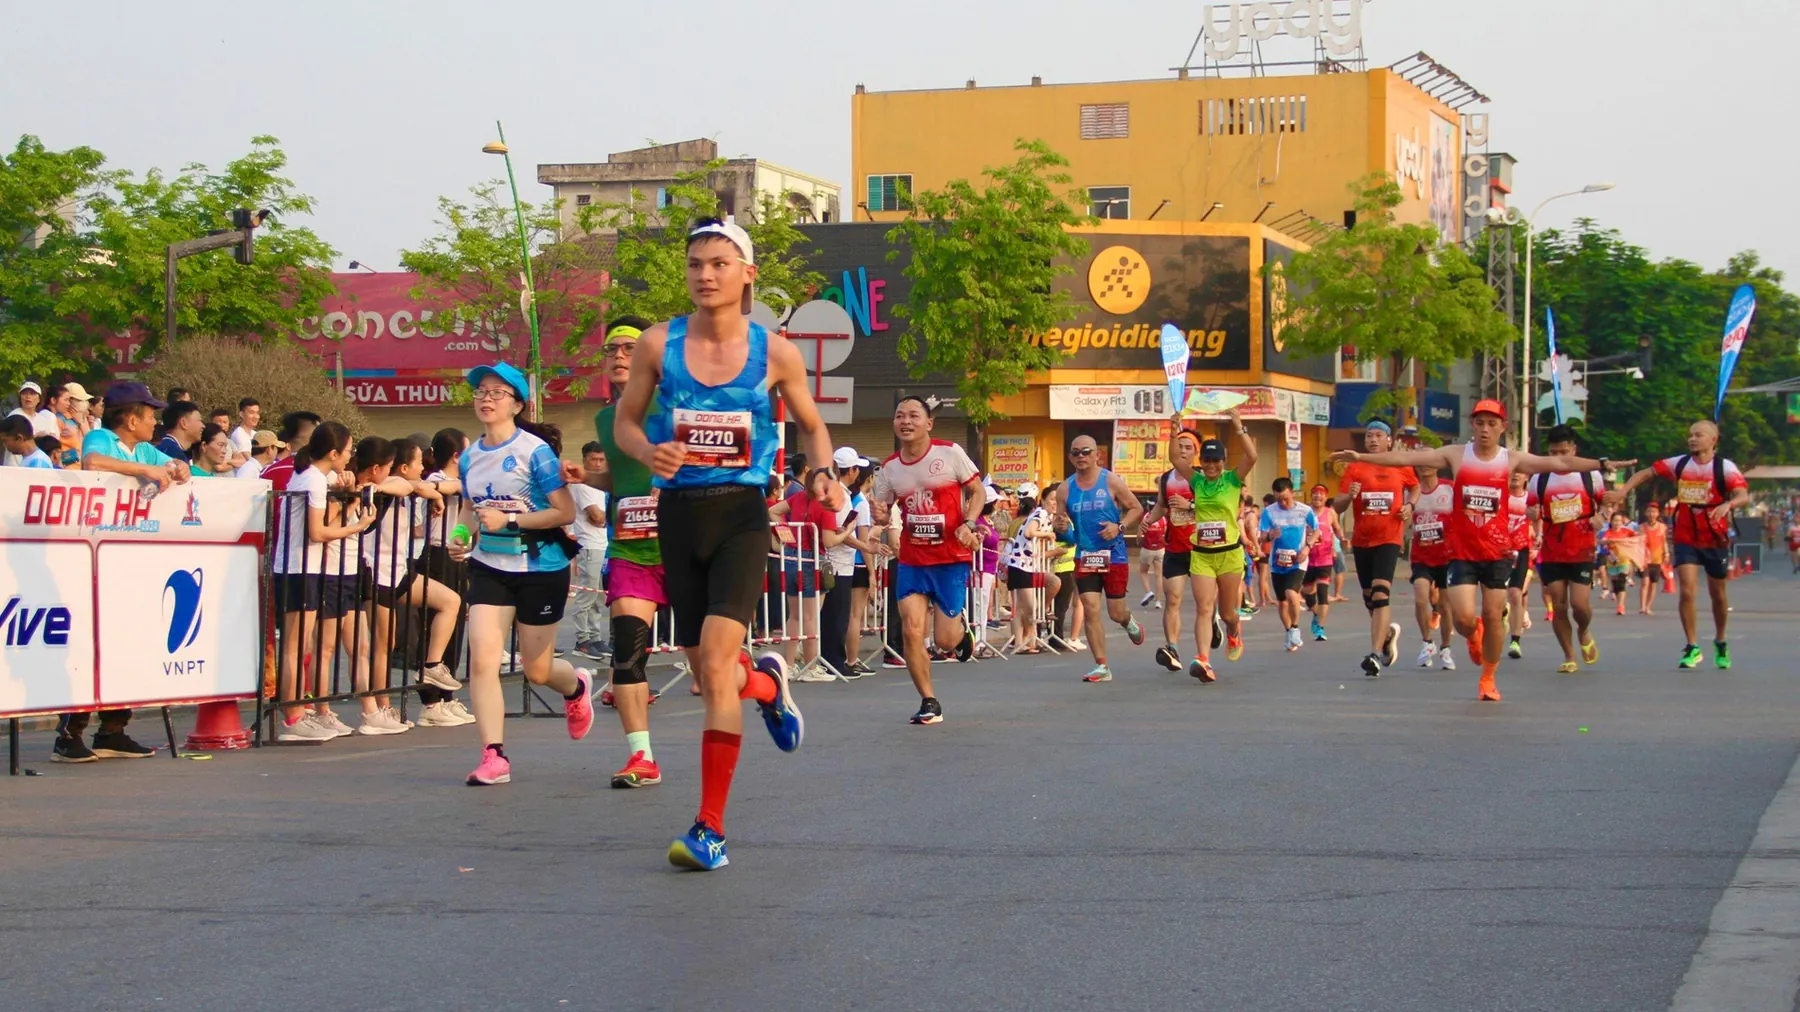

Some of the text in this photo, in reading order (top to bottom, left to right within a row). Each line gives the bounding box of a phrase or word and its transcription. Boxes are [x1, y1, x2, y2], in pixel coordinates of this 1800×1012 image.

[1204, 0, 1363, 61] yody
[444, 340, 479, 352] .com
[345, 381, 453, 403] SỮA THÙN
[1073, 396, 1127, 408] Galaxy Fit3
[694, 413, 723, 424] DONG
[688, 429, 734, 446] 21270
[993, 463, 1028, 472] LAPTOP
[23, 484, 107, 527] DONG
[1469, 496, 1493, 507] 21726
[624, 509, 658, 522] 21664
[914, 524, 936, 533] 21715
[1202, 529, 1219, 537] 21631
[163, 660, 205, 675] VNPT
